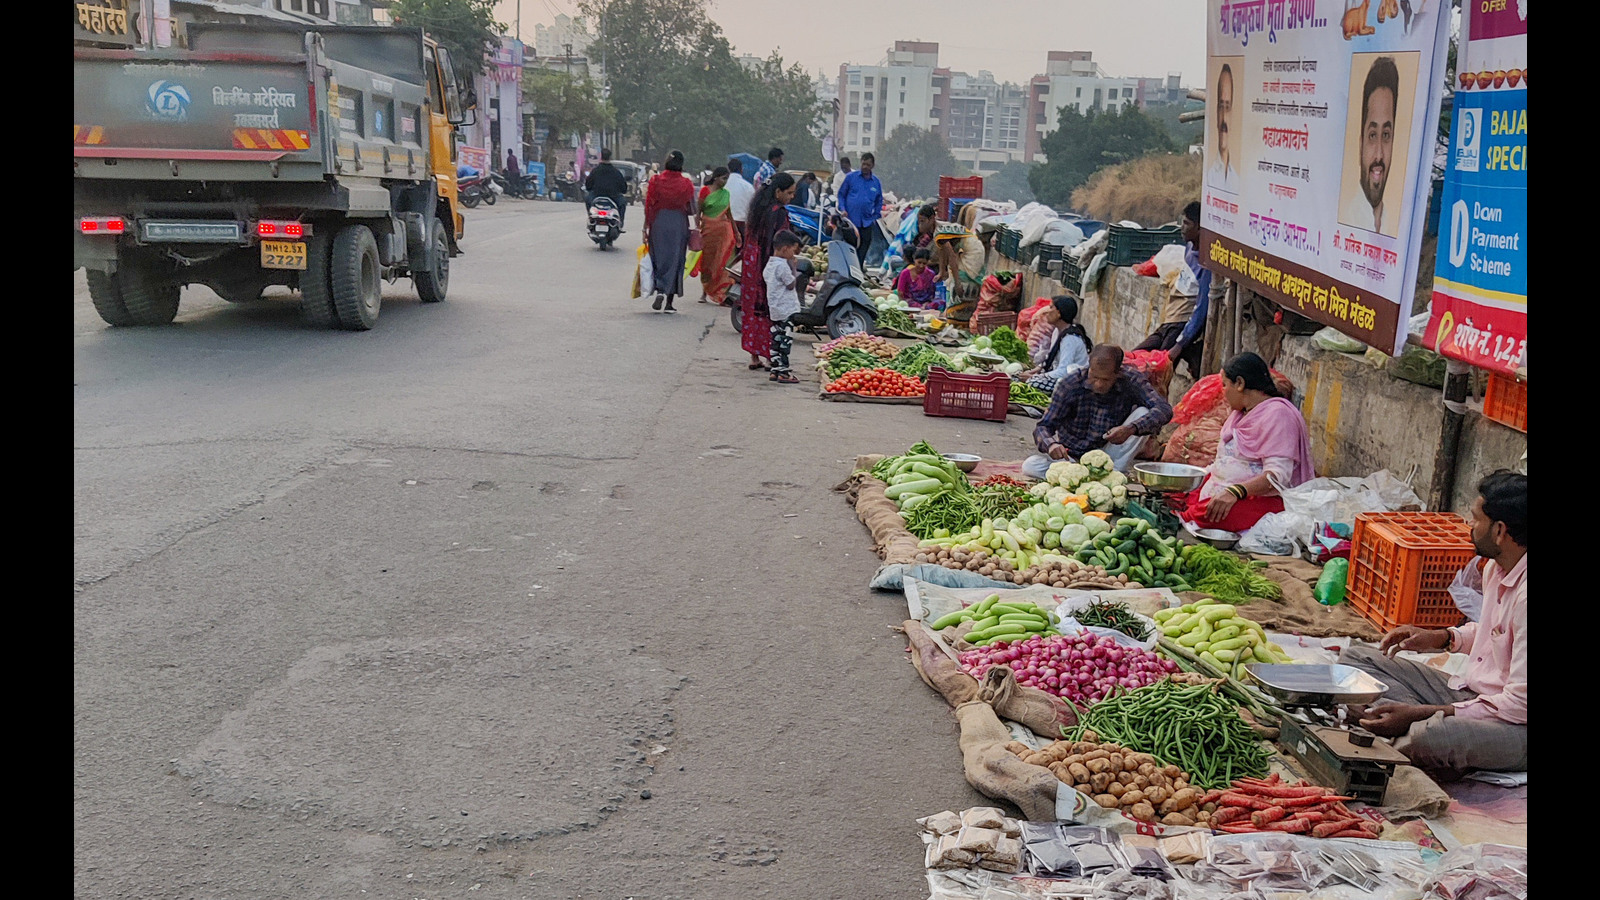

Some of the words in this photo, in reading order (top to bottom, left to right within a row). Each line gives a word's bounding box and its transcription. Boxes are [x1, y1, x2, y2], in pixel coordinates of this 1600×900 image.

[76, 2, 128, 35] महादेव
[253, 86, 296, 107] मटेरियल
[1490, 109, 1527, 136] BAJA
[1485, 145, 1527, 171] SPECI
[1473, 201, 1502, 222] Down
[1471, 226, 1519, 252] Payment
[265, 254, 303, 266] 2727
[1470, 252, 1511, 277] Scheme
[1349, 295, 1376, 331] मंडळ
